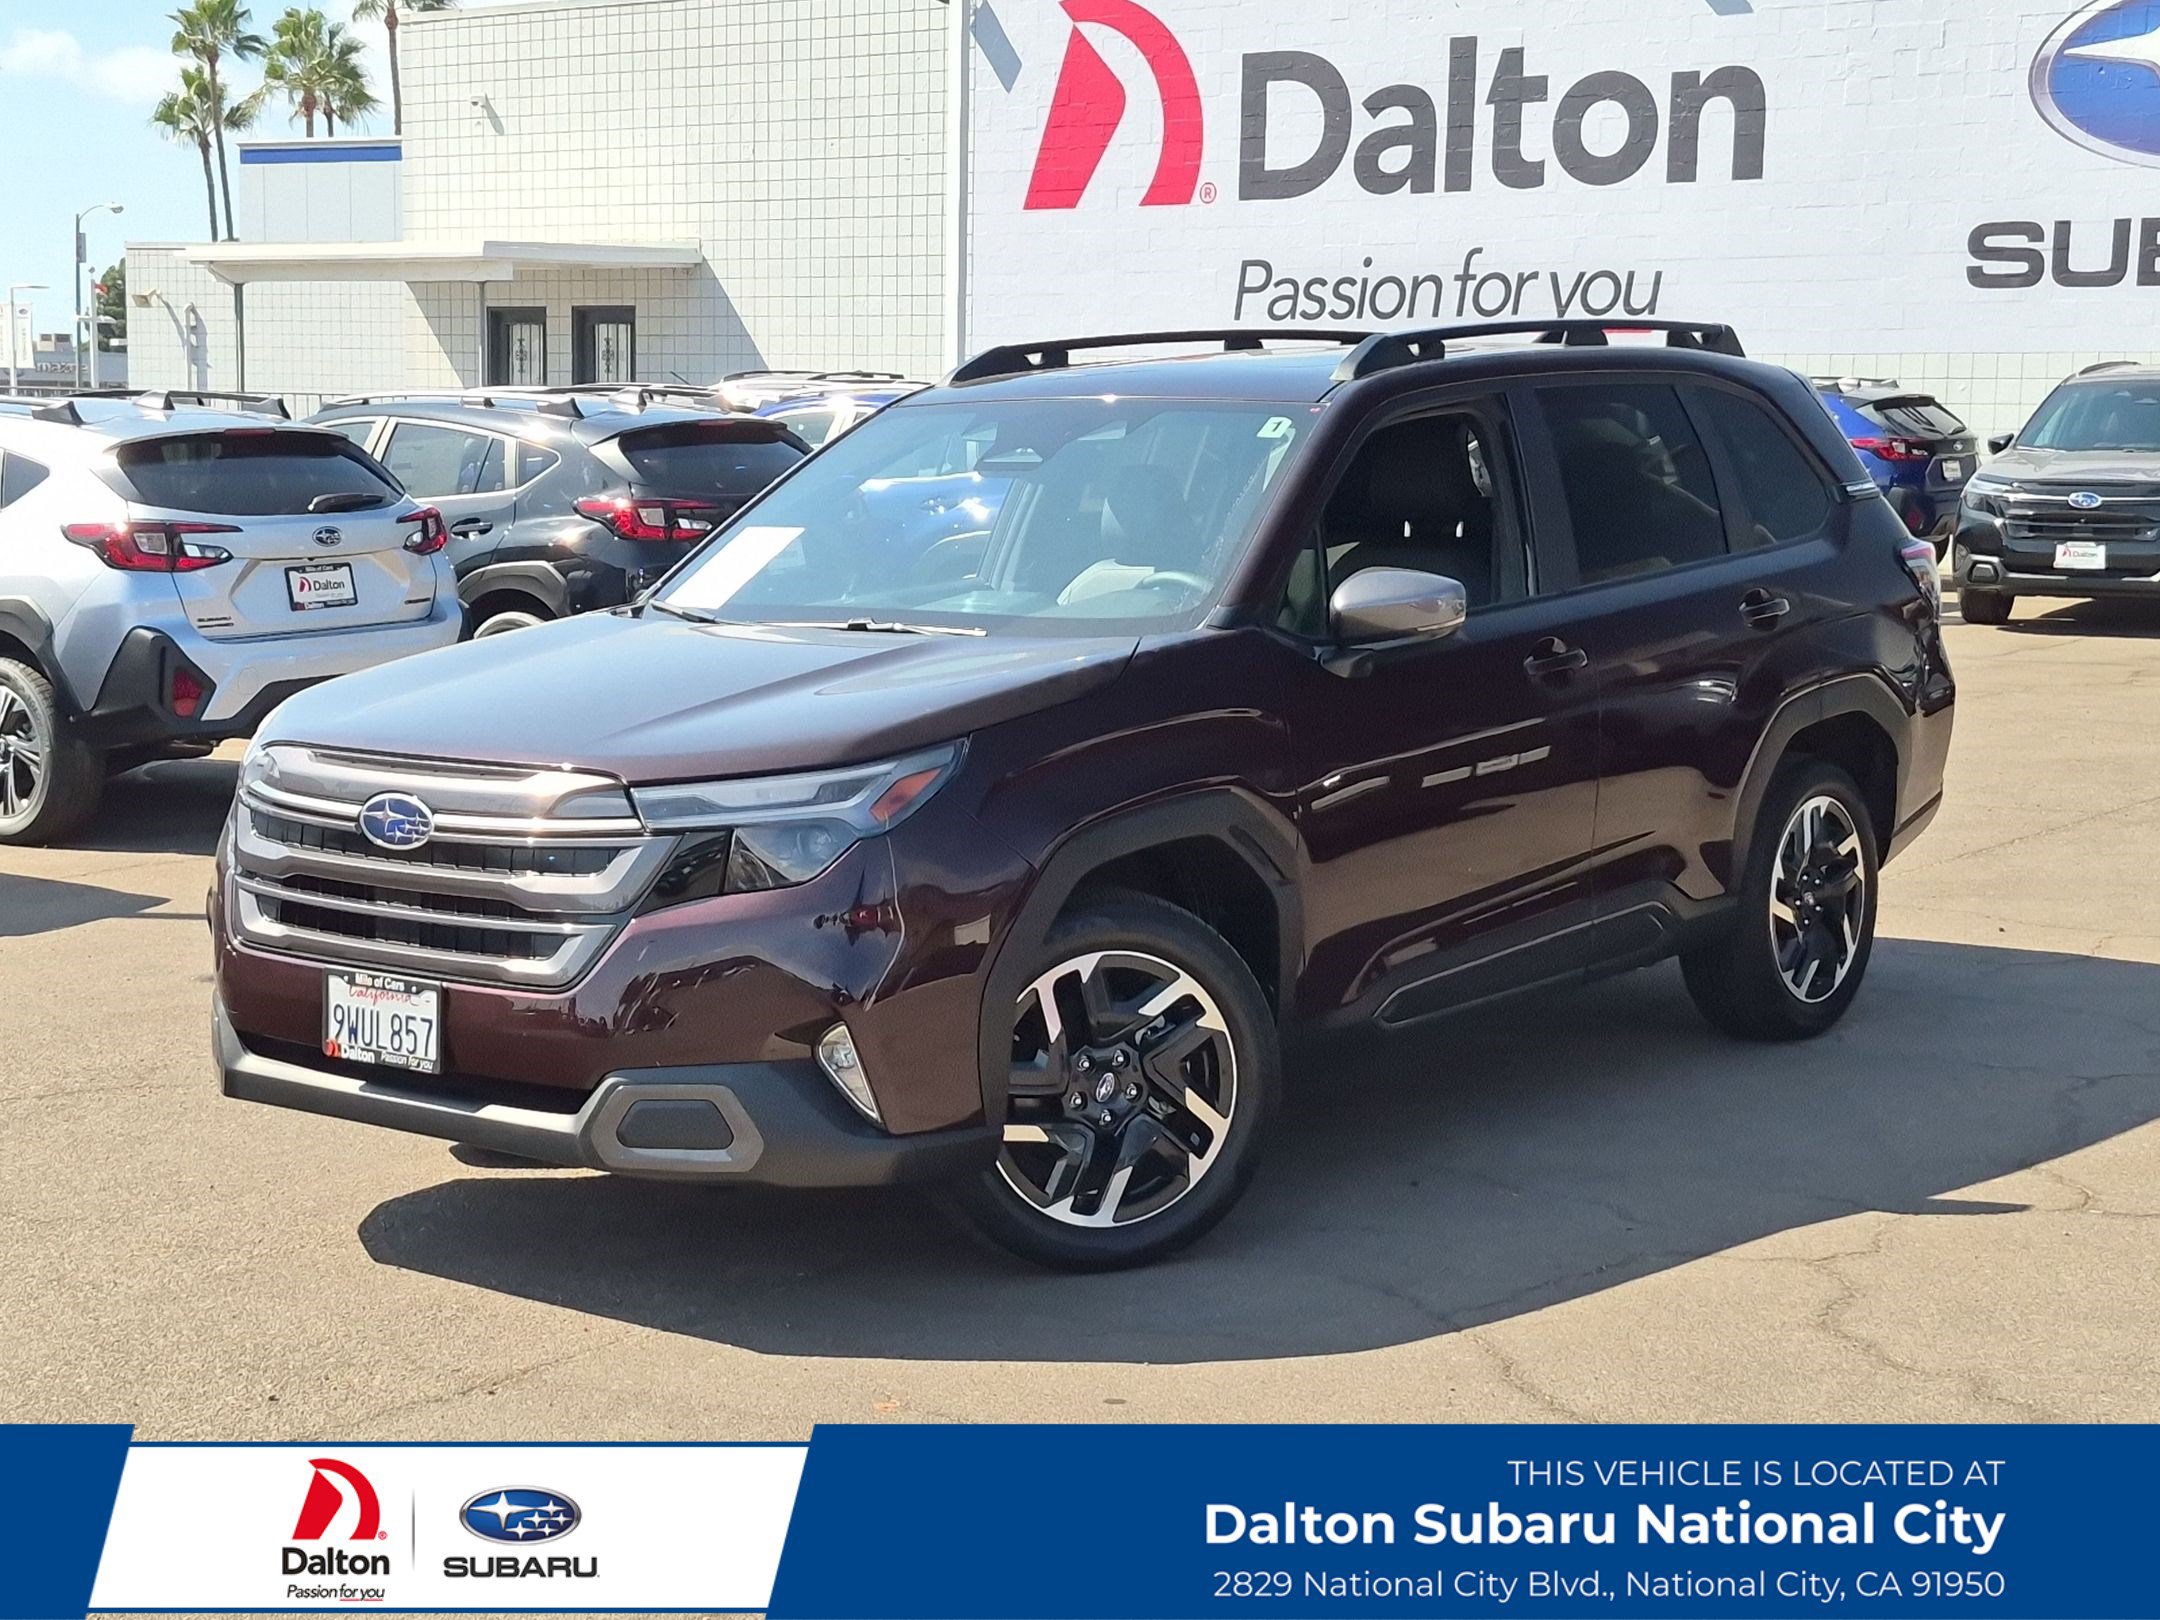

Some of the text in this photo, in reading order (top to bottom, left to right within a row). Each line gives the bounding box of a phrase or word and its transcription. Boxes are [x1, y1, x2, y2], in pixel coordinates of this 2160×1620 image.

[1239, 36, 1766, 201] Dalton
[1234, 247, 1663, 321] Passion for you
[313, 578, 345, 591] Dalton
[355, 973, 405, 991] Mile of Cars
[348, 985, 420, 1007] California
[333, 1003, 434, 1058] 9WUL857
[341, 1044, 434, 1070] Dalton Passion for you
